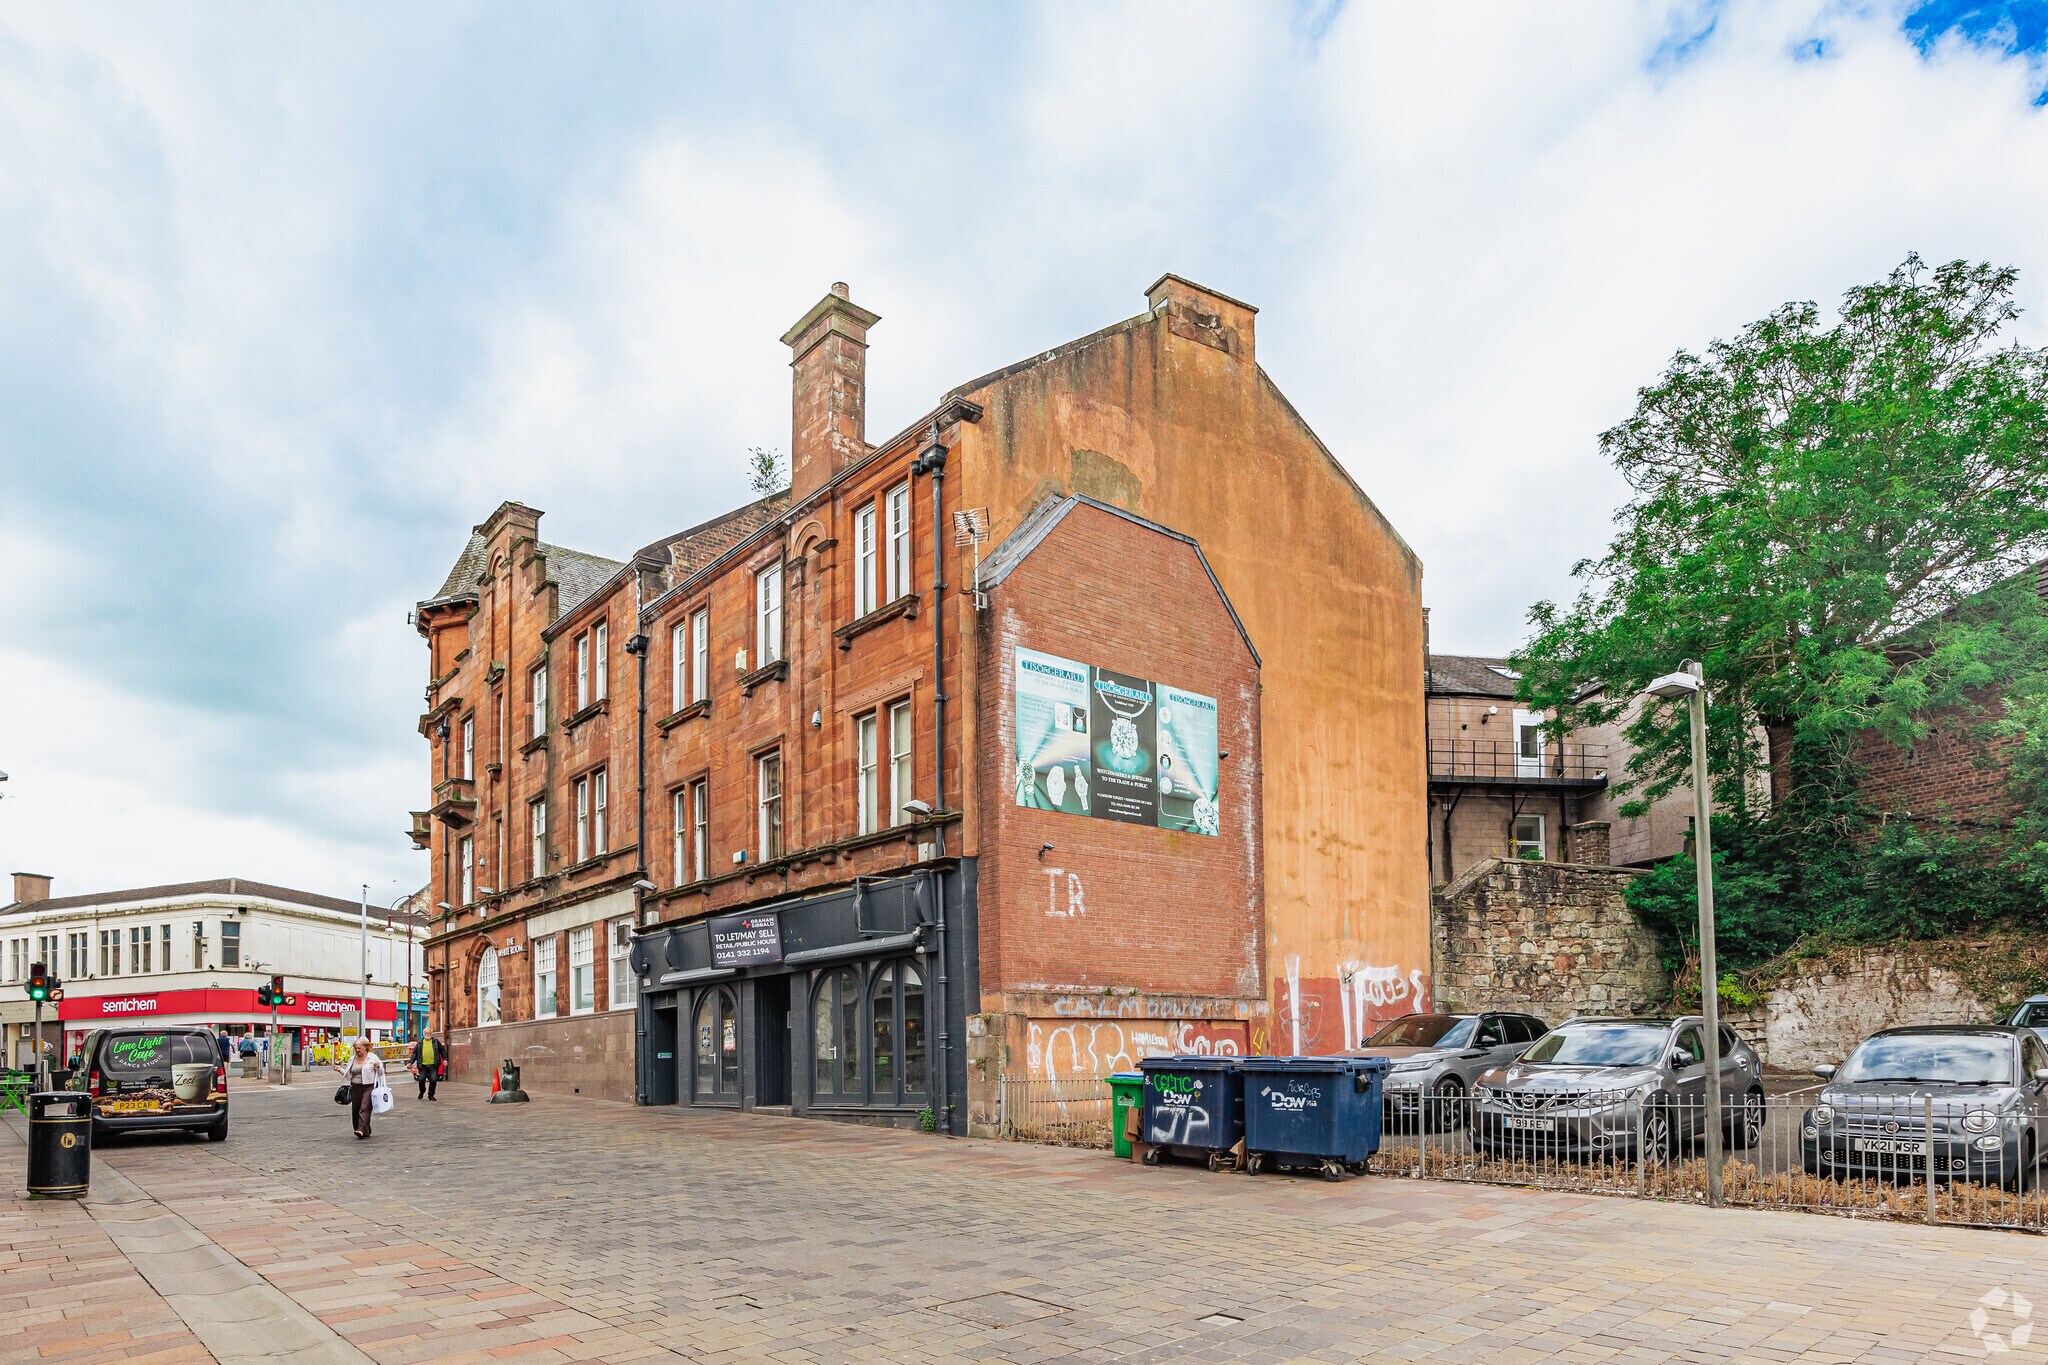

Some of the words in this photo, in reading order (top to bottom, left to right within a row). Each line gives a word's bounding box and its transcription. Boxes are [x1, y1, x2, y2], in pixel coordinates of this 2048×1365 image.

[715, 934, 725, 942] TO
[727, 931, 757, 941] LET/MAY
[758, 929, 775, 938] SELL
[715, 940, 756, 949] RETAIL/PUBLIC
[757, 938, 776, 946] HOUSE
[716, 951, 735, 959] 0141
[736, 949, 751, 957] 332
[752, 947, 770, 955] 1194
[102, 998, 157, 1013] semichem
[307, 1000, 355, 1012] semichem
[1054, 997, 1141, 1018] CALM
[113, 1041, 137, 1053] Lime
[137, 1035, 167, 1050] Light
[1131, 1030, 1168, 1047] HAMILTON
[119, 1059, 140, 1069] DANCE
[143, 1054, 164, 1068] STUDIO
[128, 1048, 155, 1062] Cafe
[174, 1074, 199, 1086] Zest
[137, 1101, 153, 1109] CAF
[1863, 1140, 1891, 1151] YK21
[1895, 1142, 1920, 1153] WSR
